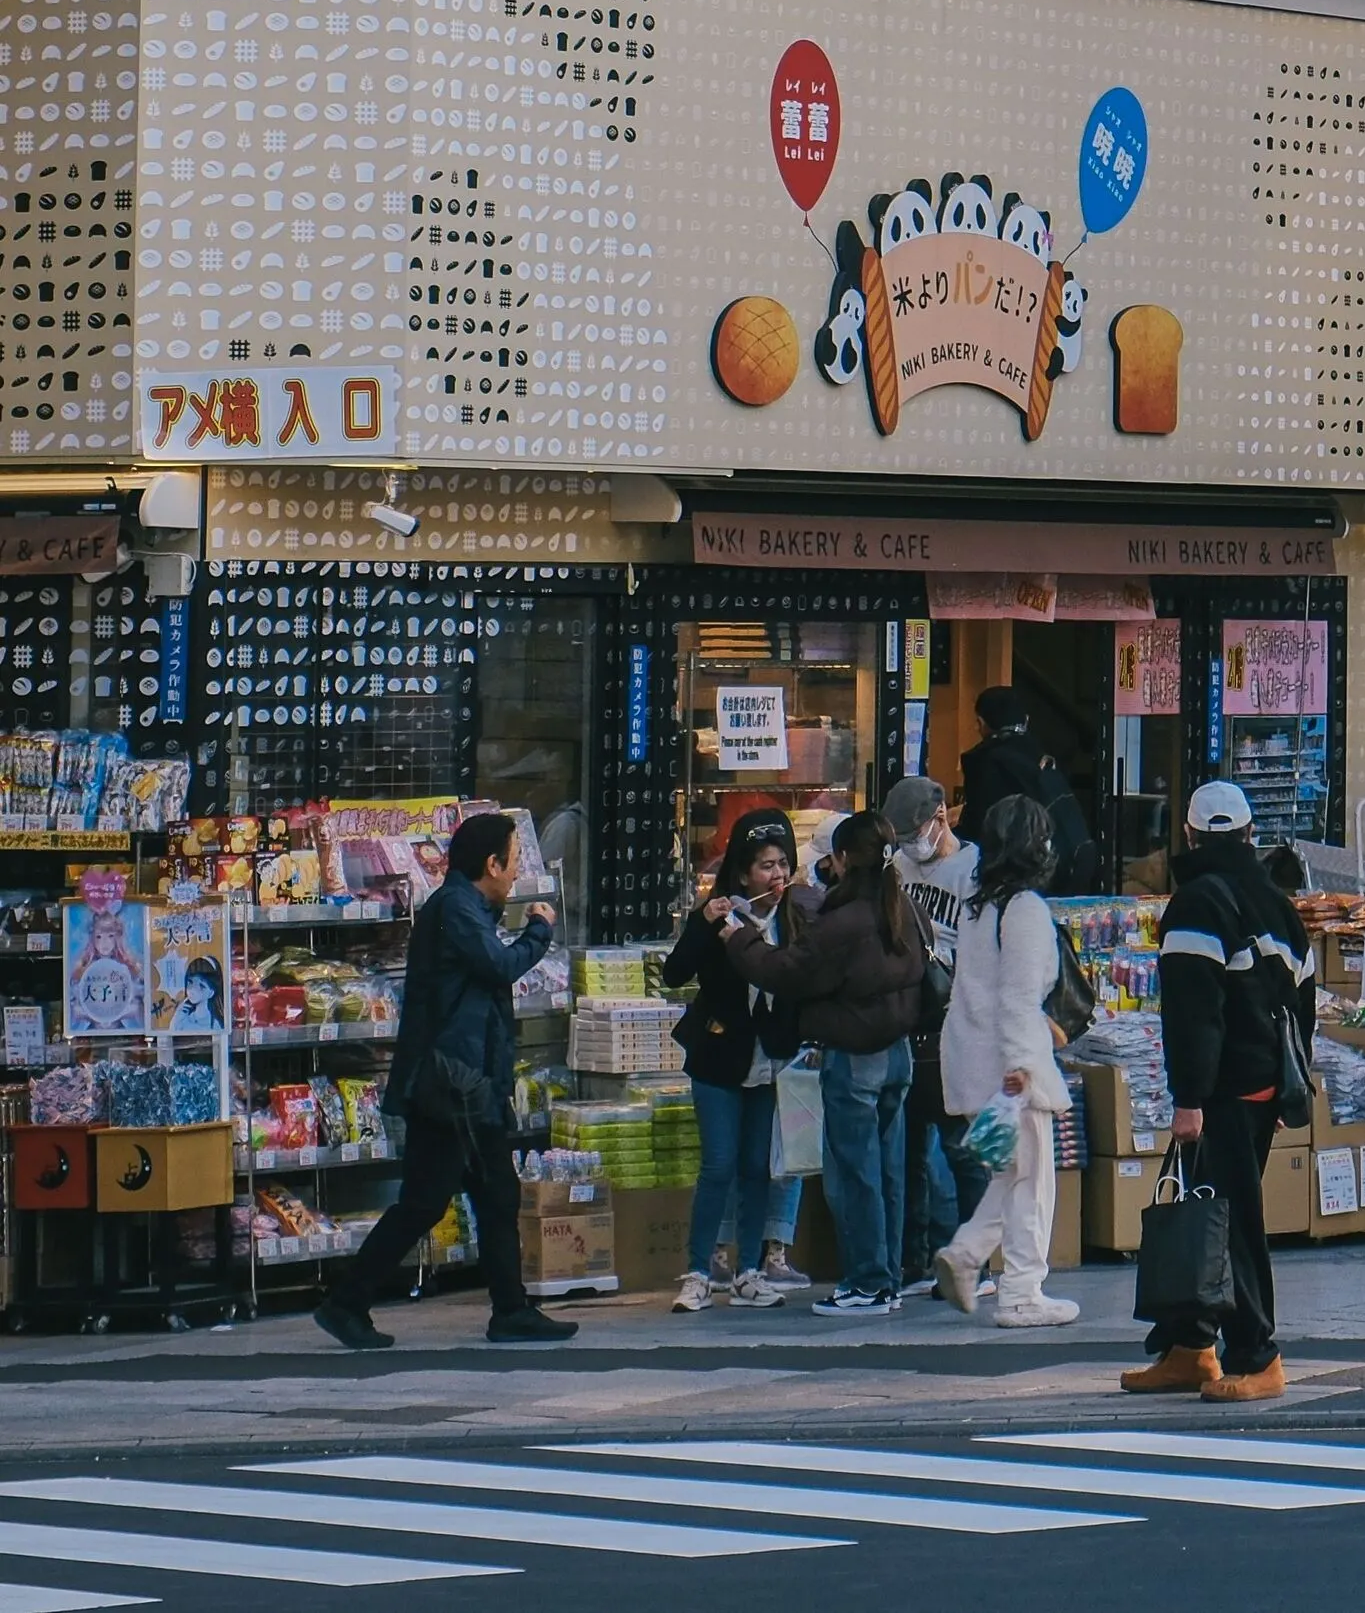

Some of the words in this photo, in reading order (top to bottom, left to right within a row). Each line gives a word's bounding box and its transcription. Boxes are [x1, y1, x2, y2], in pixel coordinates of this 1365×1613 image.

[784, 78, 801, 95] レイ
[810, 81, 827, 98] レイ
[784, 145, 802, 161] Lei
[807, 147, 825, 162] Lei
[1086, 154, 1106, 181] Xiao
[1105, 180, 1126, 204] Xiao
[891, 249, 1039, 325] 米よりパンだ!?
[901, 352, 926, 381] NIKI
[931, 341, 979, 365] BAKERY
[983, 349, 994, 369] &
[999, 355, 1029, 391] CAFE
[149, 376, 262, 450] アメ横
[17, 539, 32, 562] &
[43, 535, 105, 562] CAFE
[701, 524, 747, 556] NIKI
[758, 529, 841, 559] BAKERY
[853, 530, 869, 559] &
[880, 532, 932, 561] CAFE
[1127, 538, 1168, 565] NIKI
[1178, 539, 1248, 566] BAKERY
[1258, 541, 1272, 566] &
[1281, 539, 1328, 566] CAFE
[167, 597, 184, 718] 防犯カメラ作動中
[542, 1223, 575, 1238] HATA
